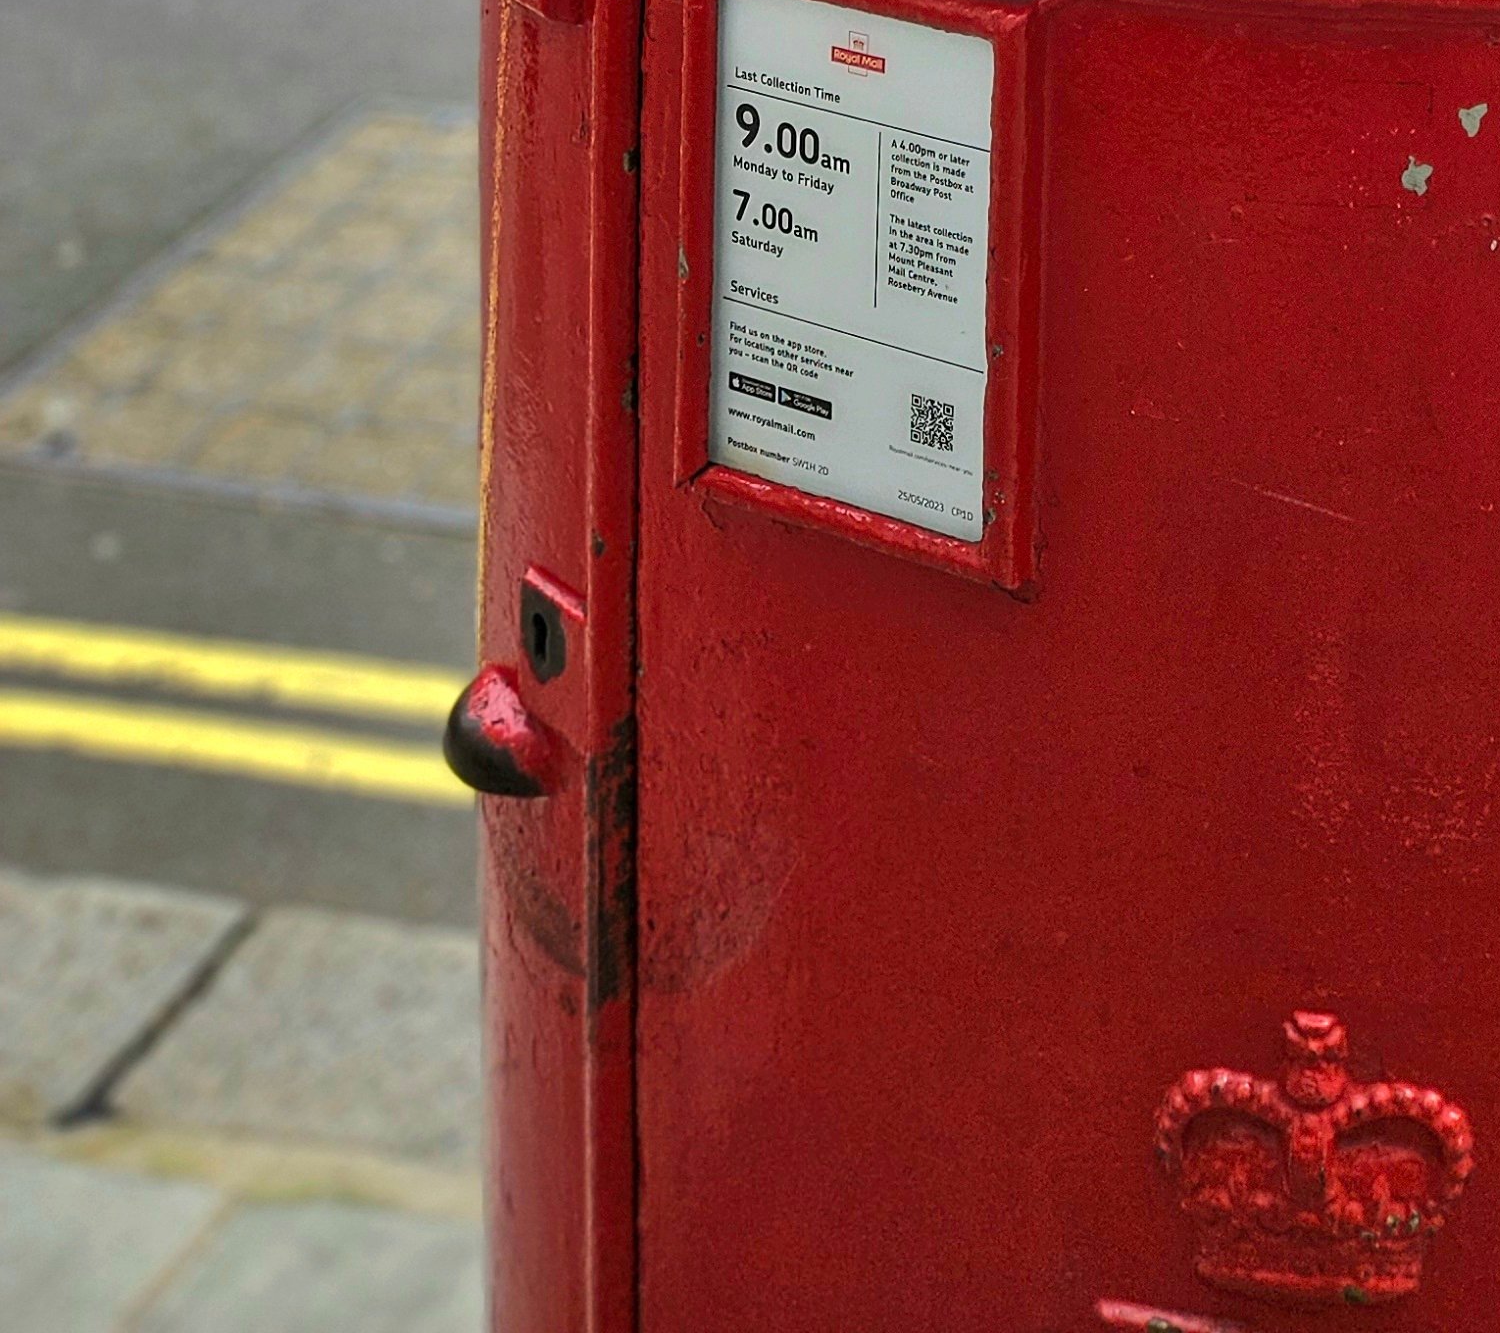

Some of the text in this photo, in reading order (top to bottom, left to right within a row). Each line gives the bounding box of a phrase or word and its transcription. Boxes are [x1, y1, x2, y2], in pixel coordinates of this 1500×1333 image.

[834, 49, 883, 70] Royal Mail
[735, 67, 840, 103] Last Collection Time
[736, 103, 850, 175] 9.00am
[891, 139, 970, 166] A 4.00pm or later
[734, 155, 834, 195] Monday to Friday
[891, 154, 966, 178] collection is made
[891, 164, 974, 193] from the Postbox at
[890, 176, 952, 201] Broadway Post
[890, 189, 915, 203] Office
[733, 189, 818, 243] 7.00am
[889, 213, 973, 244] The latest collection
[732, 231, 784, 258] Saturday
[889, 226, 969, 256] in the area is made
[889, 241, 956, 266] at 7.30pm from
[888, 264, 938, 287] Mail Centre,
[889, 252, 953, 278] Mount Pleasant
[730, 280, 779, 304] Services
[888, 276, 958, 304] Rosebery Avenue
[730, 321, 827, 358] Find us on the app store.
[729, 348, 743, 357] you
[752, 354, 769, 364] scan
[771, 358, 784, 369] the
[786, 362, 798, 373] QR
[800, 368, 818, 379] code
[730, 333, 854, 377] For locating other services near
[729, 409, 815, 441] www.royalmail.com
[728, 437, 757, 453] Postbox
[760, 449, 790, 463] number
[898, 490, 944, 512] 25/05/2023
